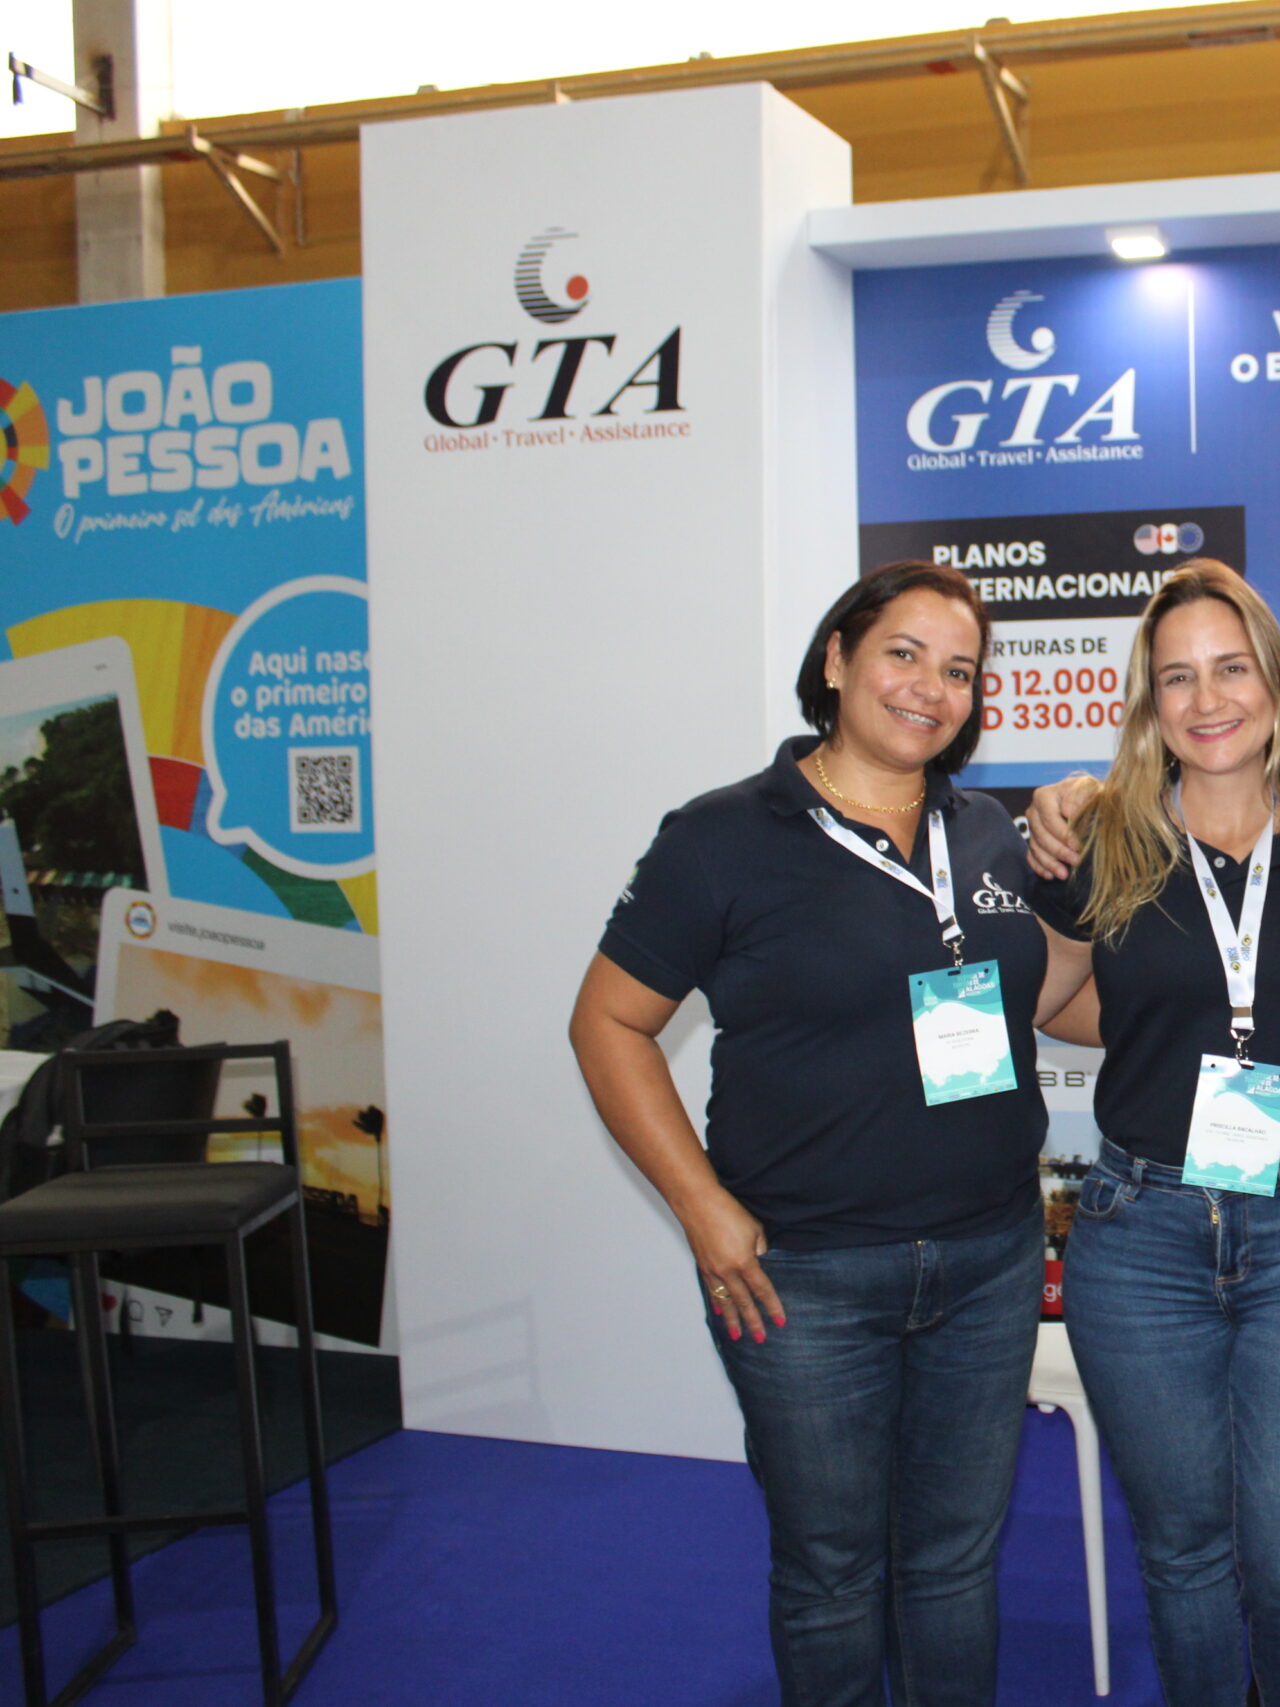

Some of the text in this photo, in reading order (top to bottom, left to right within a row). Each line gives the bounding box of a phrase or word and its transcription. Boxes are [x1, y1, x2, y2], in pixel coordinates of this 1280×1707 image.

[423, 324, 687, 429] GTA
[1230, 353, 1259, 383] O
[57, 346, 272, 436] JOÃO
[906, 368, 1141, 452] GTA
[423, 421, 691, 453] Global Travel Assistance
[58, 418, 351, 498] PESSOA
[907, 443, 1144, 472] Global Travel Assistance
[54, 503, 74, 539] O
[74, 511, 167, 544] primeiro
[932, 541, 1046, 570] PLANOS
[1081, 637, 1107, 654] DE
[248, 645, 307, 680] Aqui
[230, 675, 367, 713] o primeiro
[1012, 668, 1117, 697] 12.000
[234, 706, 371, 739] das Améri
[972, 889, 1031, 912] GTA
